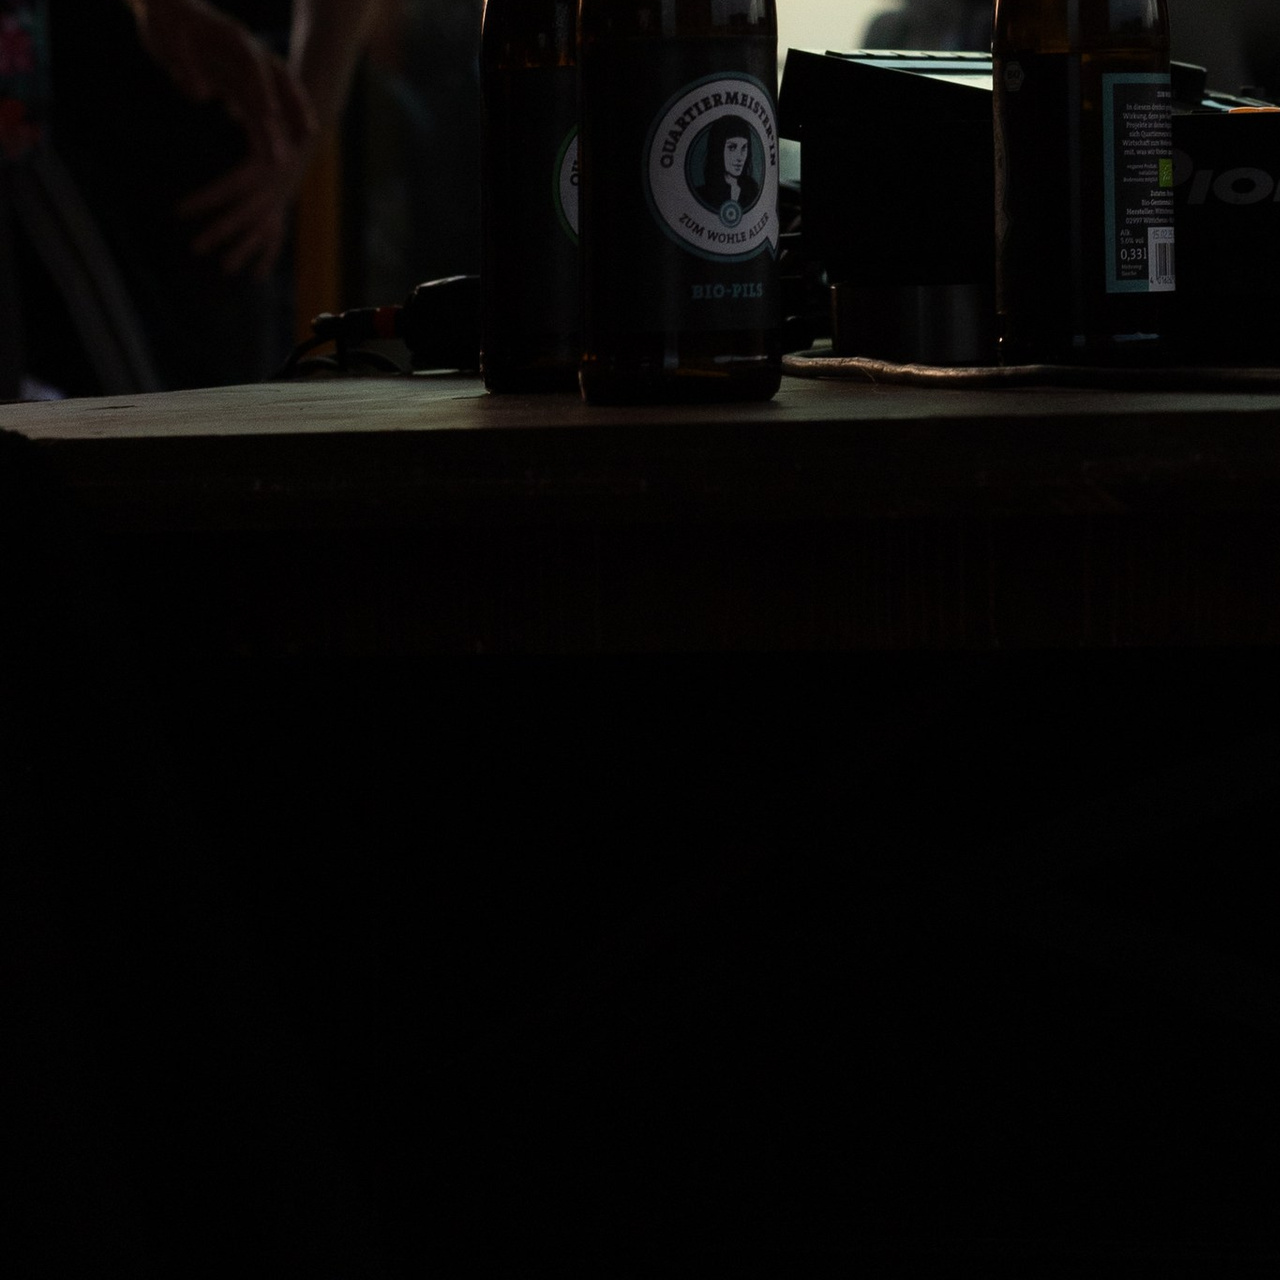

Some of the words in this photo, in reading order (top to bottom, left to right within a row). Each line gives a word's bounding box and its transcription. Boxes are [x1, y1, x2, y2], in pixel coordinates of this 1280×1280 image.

[678, 212, 706, 238] ZUM
[706, 231, 747, 245] WOHLE
[748, 211, 770, 241] ALLER
